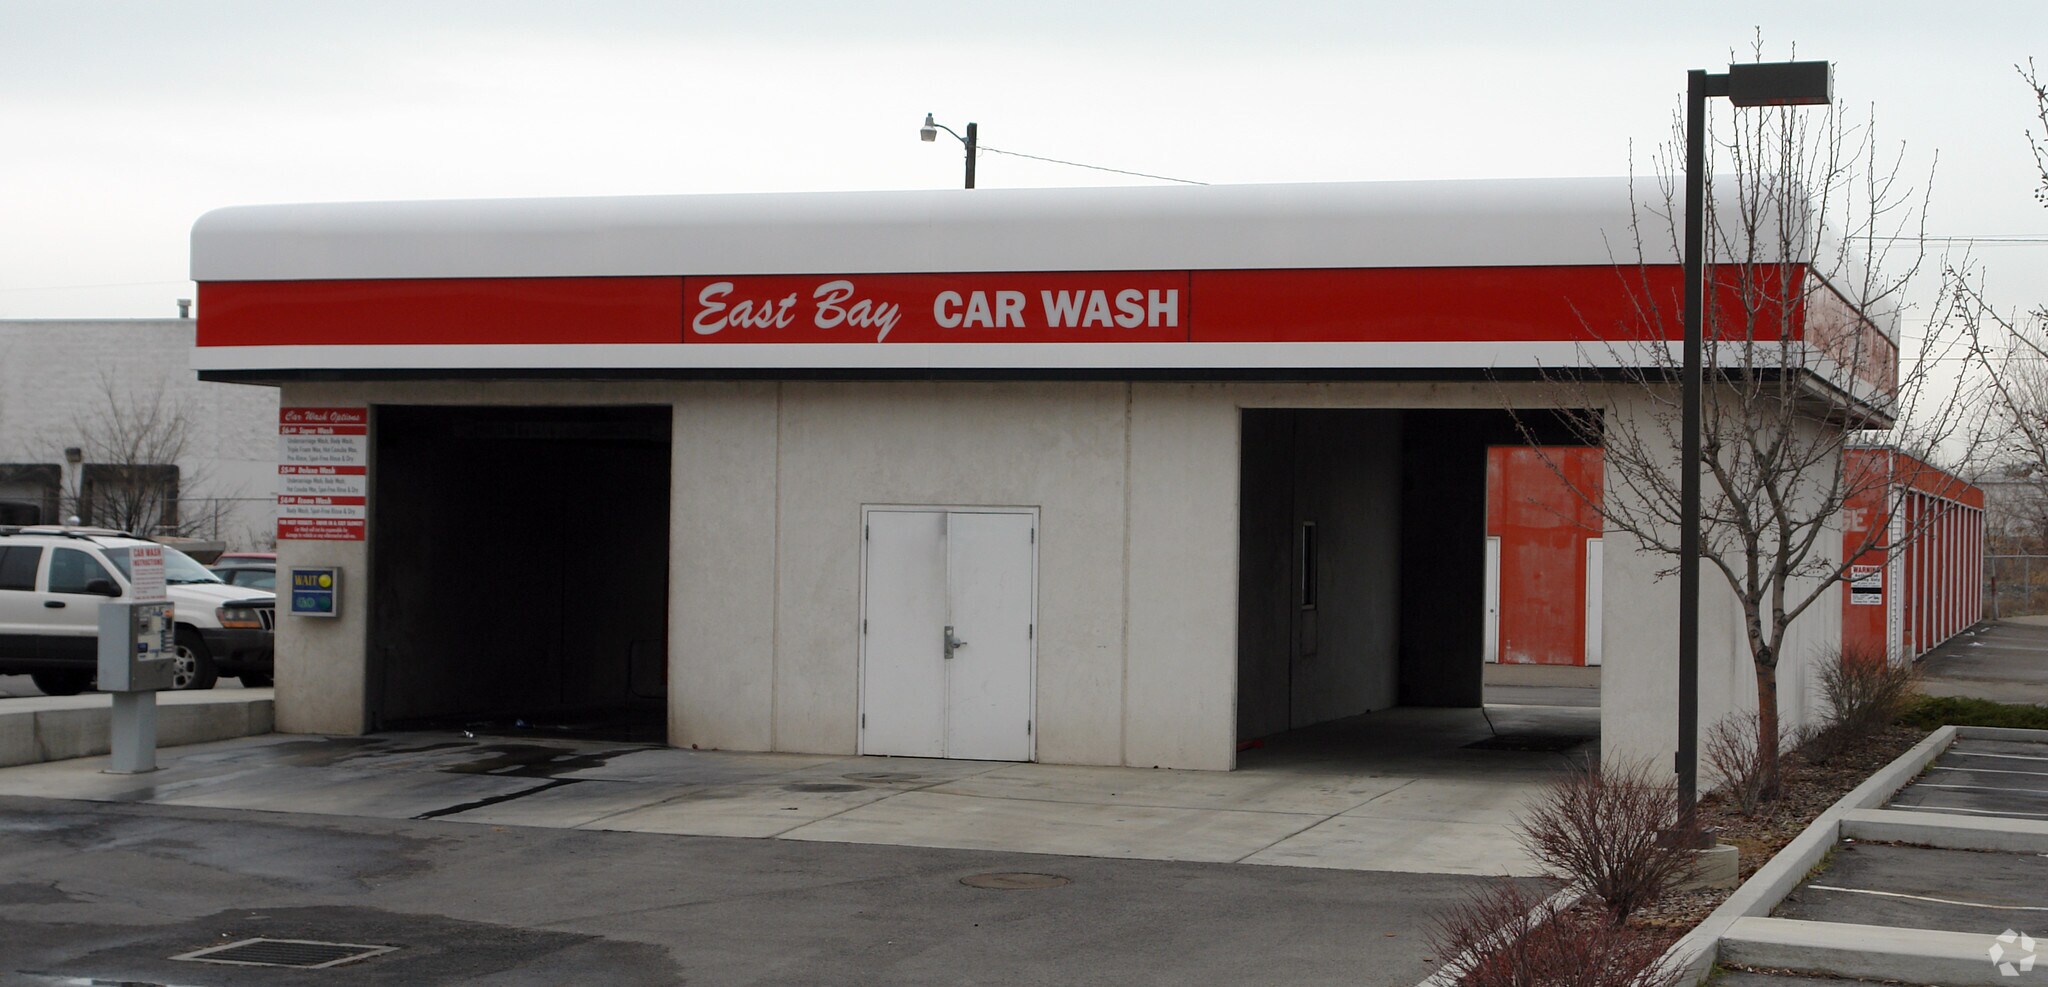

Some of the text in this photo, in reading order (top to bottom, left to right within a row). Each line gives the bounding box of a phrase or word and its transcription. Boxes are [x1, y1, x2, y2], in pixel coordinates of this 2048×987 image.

[692, 280, 1178, 343] East Bay CAR WASH
[285, 411, 360, 422] Car Wash Options
[134, 548, 161, 557] CAR WASH
[295, 575, 318, 586] WAIT
